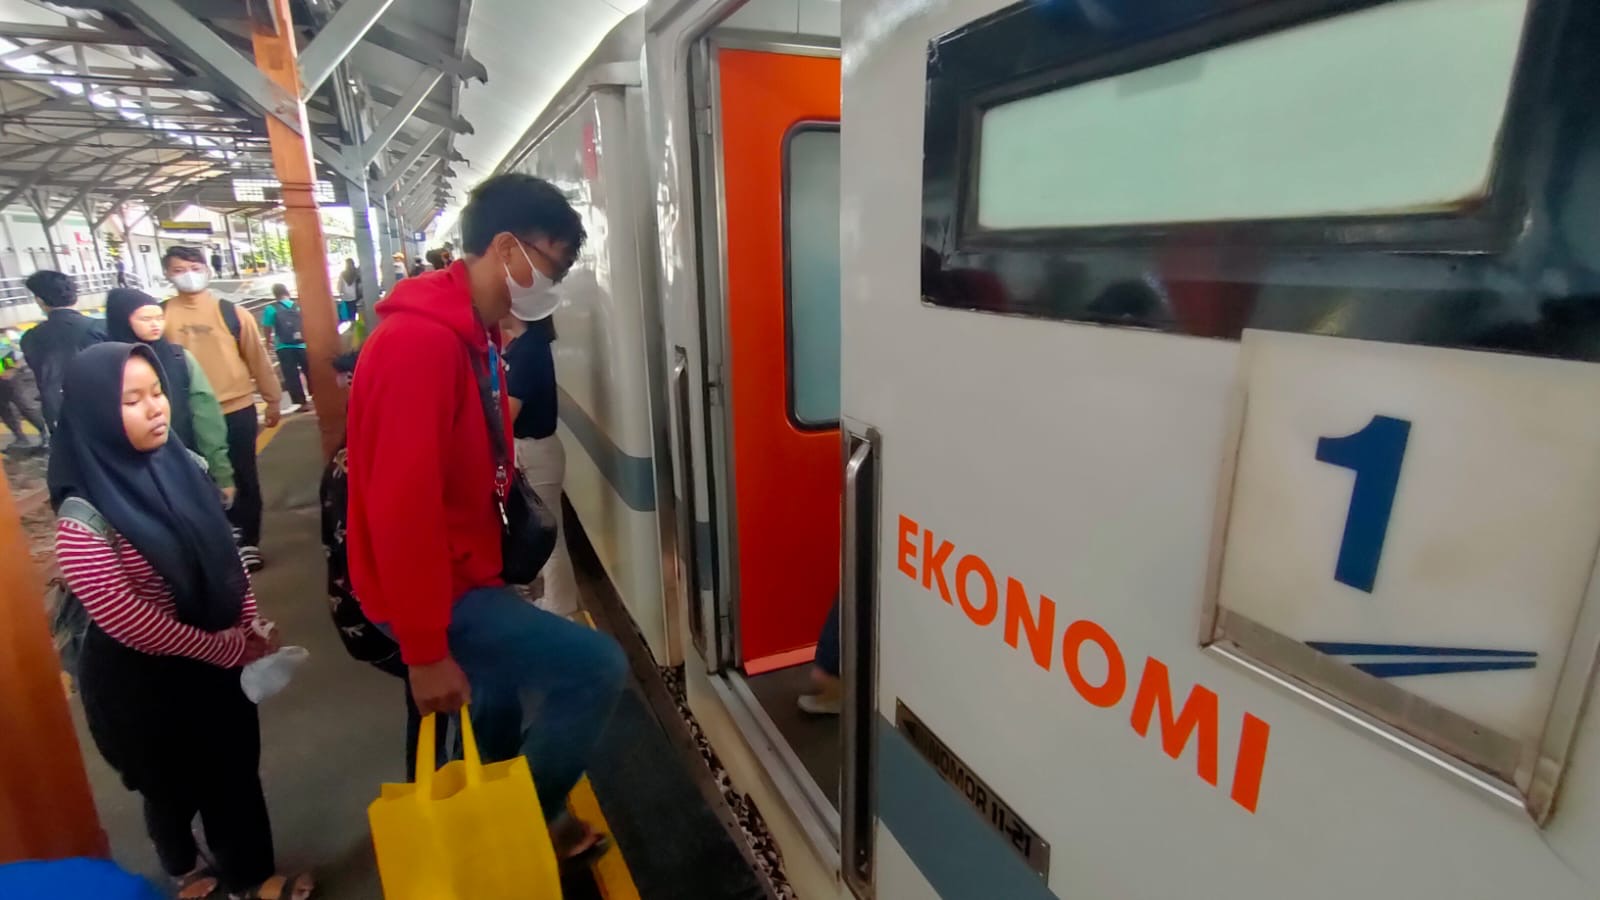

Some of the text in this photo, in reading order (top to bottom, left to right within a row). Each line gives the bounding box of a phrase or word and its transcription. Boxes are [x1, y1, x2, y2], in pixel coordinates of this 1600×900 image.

[1315, 414, 1412, 594] 1
[897, 513, 1271, 815] EKONOMI
[927, 738, 1032, 857] NOMOR 11-21
